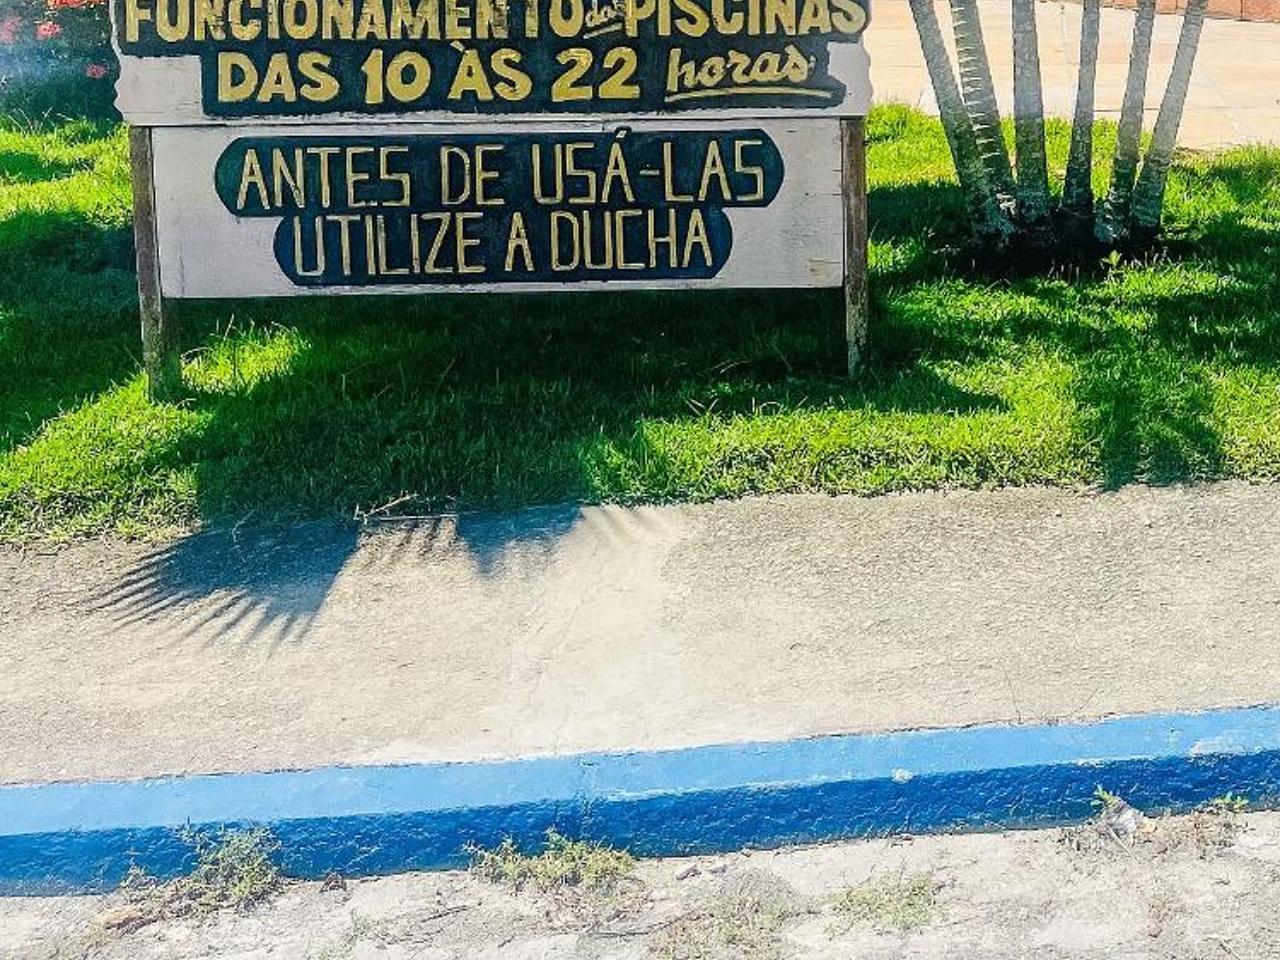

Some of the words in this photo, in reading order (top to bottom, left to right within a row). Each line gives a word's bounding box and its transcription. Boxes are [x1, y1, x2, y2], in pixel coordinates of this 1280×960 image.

[218, 51, 340, 102] DAS
[361, 47, 432, 104] 10
[448, 40, 533, 102] ÀS
[551, 46, 641, 102] 22
[664, 43, 816, 92] horas
[236, 146, 410, 210] ANTES
[440, 144, 505, 206] DE
[531, 129, 765, 205] USÁ-LAS
[293, 212, 486, 276] UTILIZE
[504, 211, 535, 272] A
[550, 208, 713, 271] DUCHA
